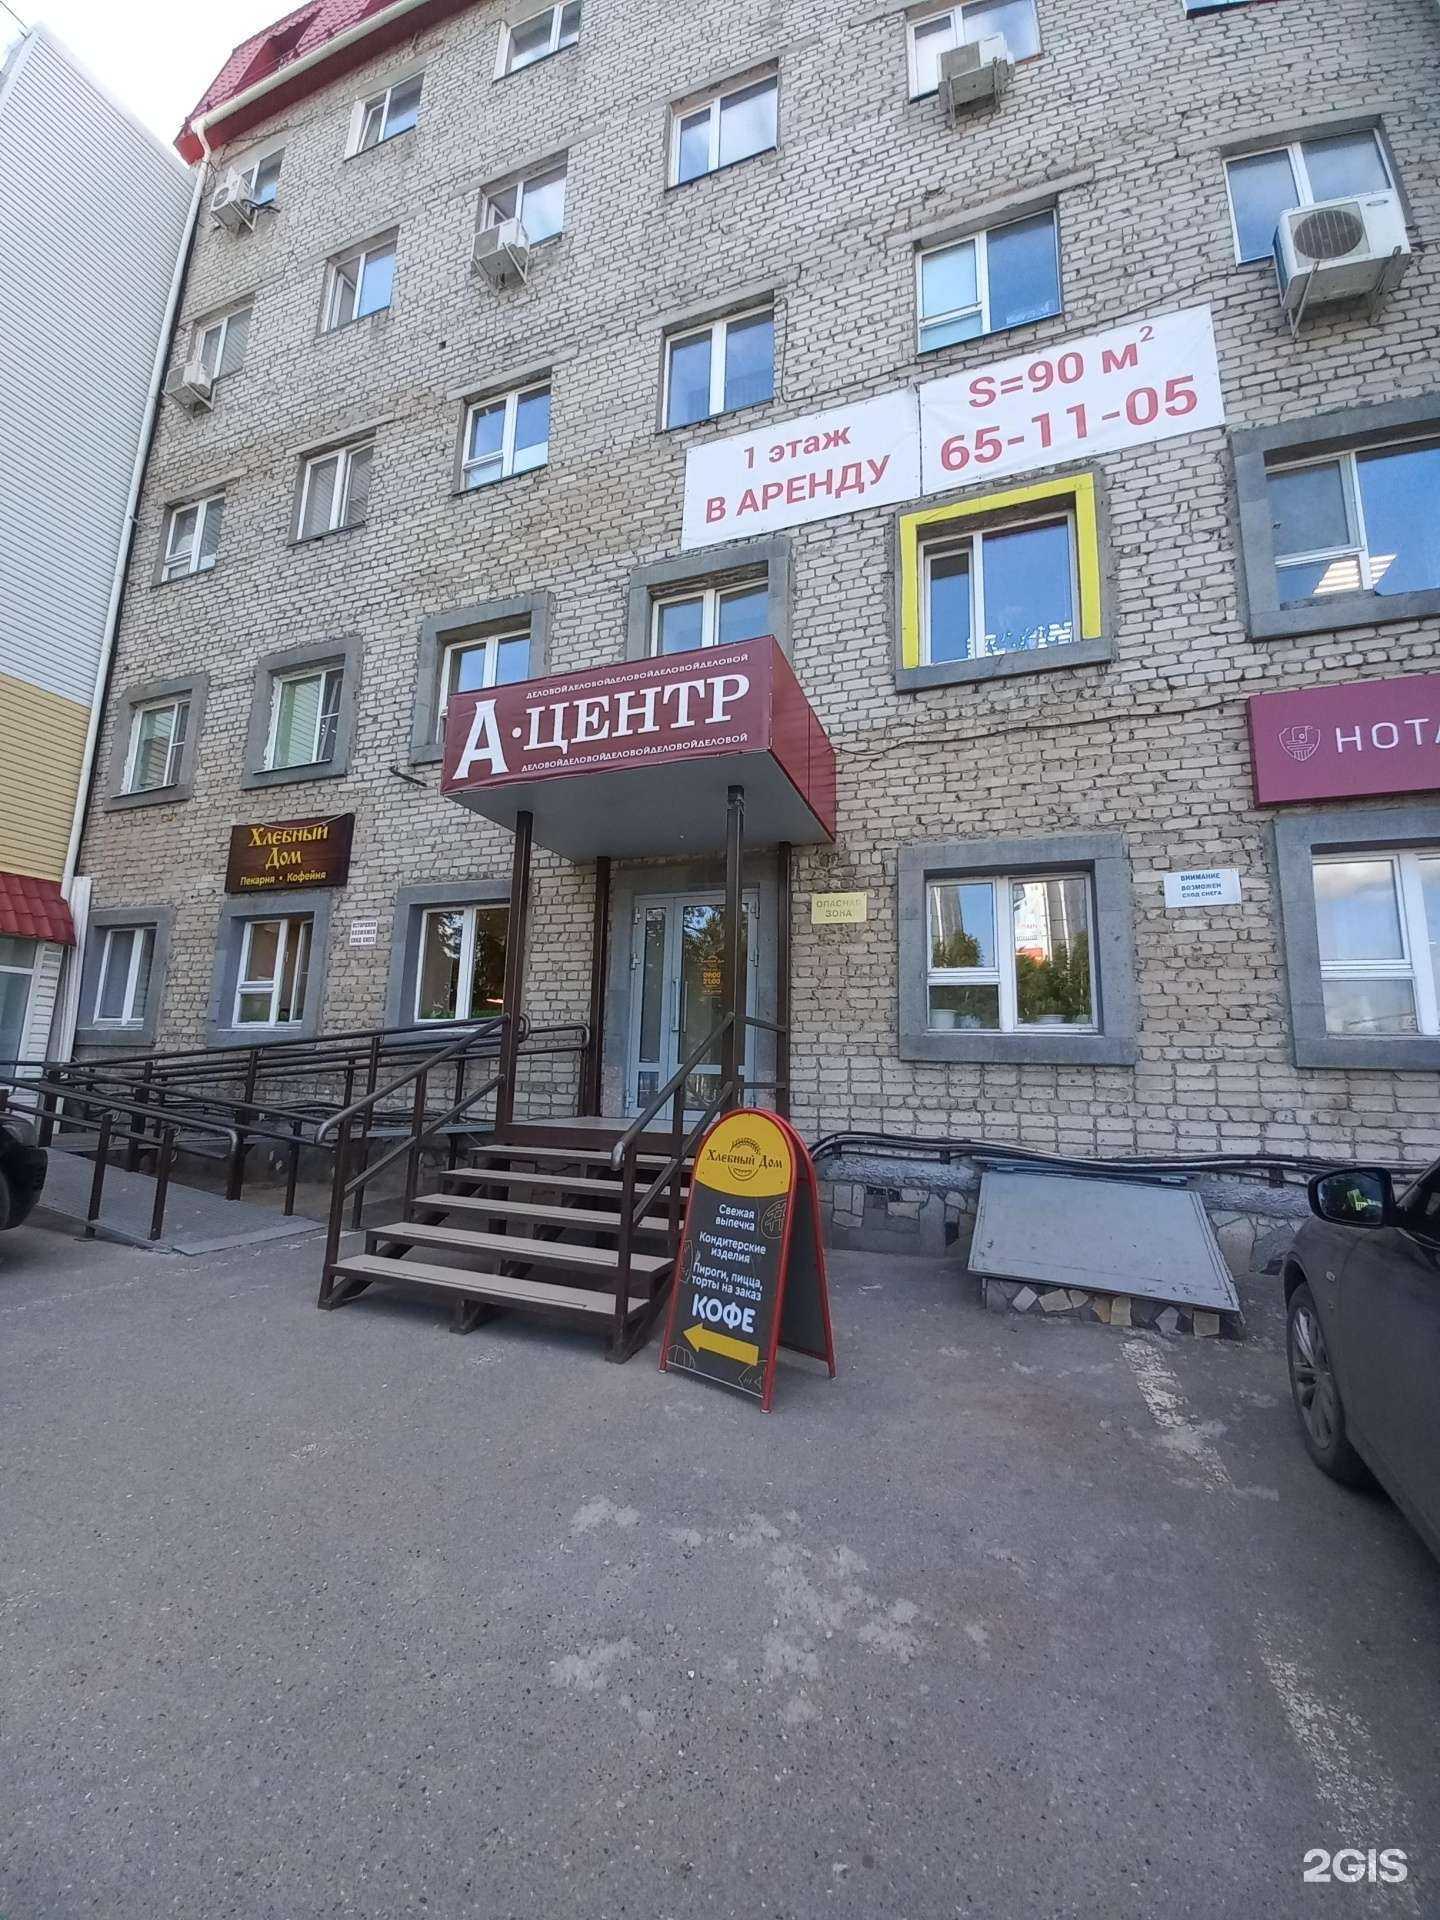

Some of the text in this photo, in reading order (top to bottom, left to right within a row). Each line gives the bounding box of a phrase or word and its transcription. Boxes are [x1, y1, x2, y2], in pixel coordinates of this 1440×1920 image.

[968, 351, 1085, 408] S=90
[940, 376, 1198, 471] 65-11-05
[744, 425, 851, 469] 1 этаж
[705, 454, 891, 524] В АРЕНДУ
[239, 870, 327, 886] Пекарня Кофейня
[715, 1216, 755, 1231] выпечка
[719, 1204, 755, 1219] Свежая
[699, 1232, 766, 1254] Кондитерские
[711, 1248, 750, 1264] изделия
[692, 1275, 761, 1301] торты на заказ
[693, 1262, 763, 1291] Пироги, пицца,
[692, 1293, 756, 1333] КОФЕ
